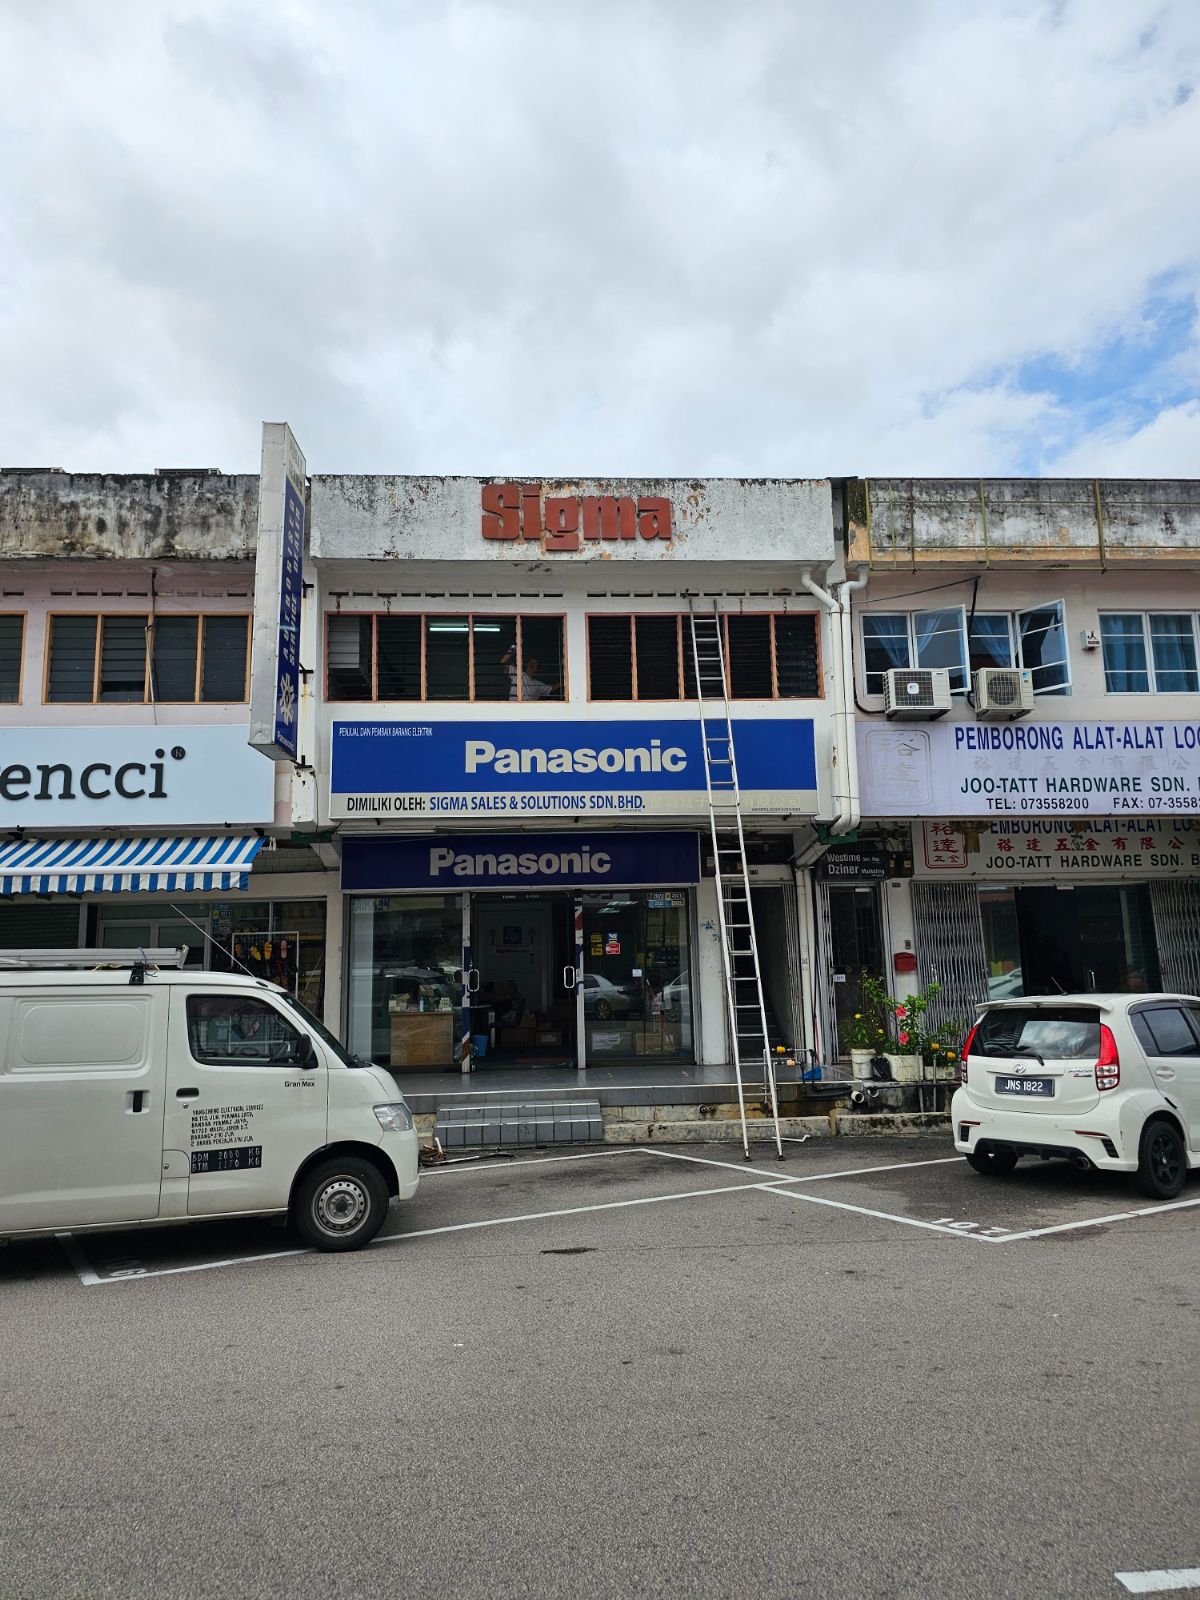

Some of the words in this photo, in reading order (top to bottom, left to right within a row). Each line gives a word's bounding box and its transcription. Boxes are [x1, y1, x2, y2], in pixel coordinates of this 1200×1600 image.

[482, 484, 672, 552] Sigma
[292, 504, 302, 574] DEALER
[283, 499, 295, 660] AUTHORISED
[360, 727, 371, 737] DAN
[392, 727, 411, 737] BARANG
[955, 726, 1064, 750] PEMBORONG
[1073, 725, 1164, 750] ALAT-ALAT
[1174, 725, 1200, 749] LO
[465, 739, 687, 774] Panasonic
[960, 777, 1038, 794] JOO-TATT
[1045, 777, 1142, 793] HARDWARE
[1151, 776, 1190, 792] SDN.
[347, 797, 391, 811] DIMILIKI
[394, 797, 426, 811] OLEH:
[429, 796, 468, 811] SIGMA
[471, 796, 506, 810] SALES
[509, 796, 518, 810] &
[520, 795, 586, 810] SOLUTIONS
[987, 798, 1016, 810] TEL:
[1020, 797, 1089, 810] 073558200
[1113, 797, 1144, 809] FAX:
[1148, 797, 1200, 809] 07-3558
[990, 820, 1074, 834] EMBORONG
[997, 836, 1200, 852] 裕達五金有限公
[430, 845, 611, 876] Panasonic
[986, 856, 1052, 869] JOO-TATT
[1060, 855, 1142, 868] HARDWARE
[1151, 854, 1183, 867] SDN.
[828, 864, 859, 874] Dziner
[285, 1080, 300, 1088] Gran
[1005, 1079, 1020, 1090] JNS
[1023, 1081, 1043, 1091] 1822
[192, 1153, 208, 1162] BDM
[248, 1148, 260, 1157] KG
[192, 1162, 208, 1172] BTM
[248, 1157, 260, 1166] KG
